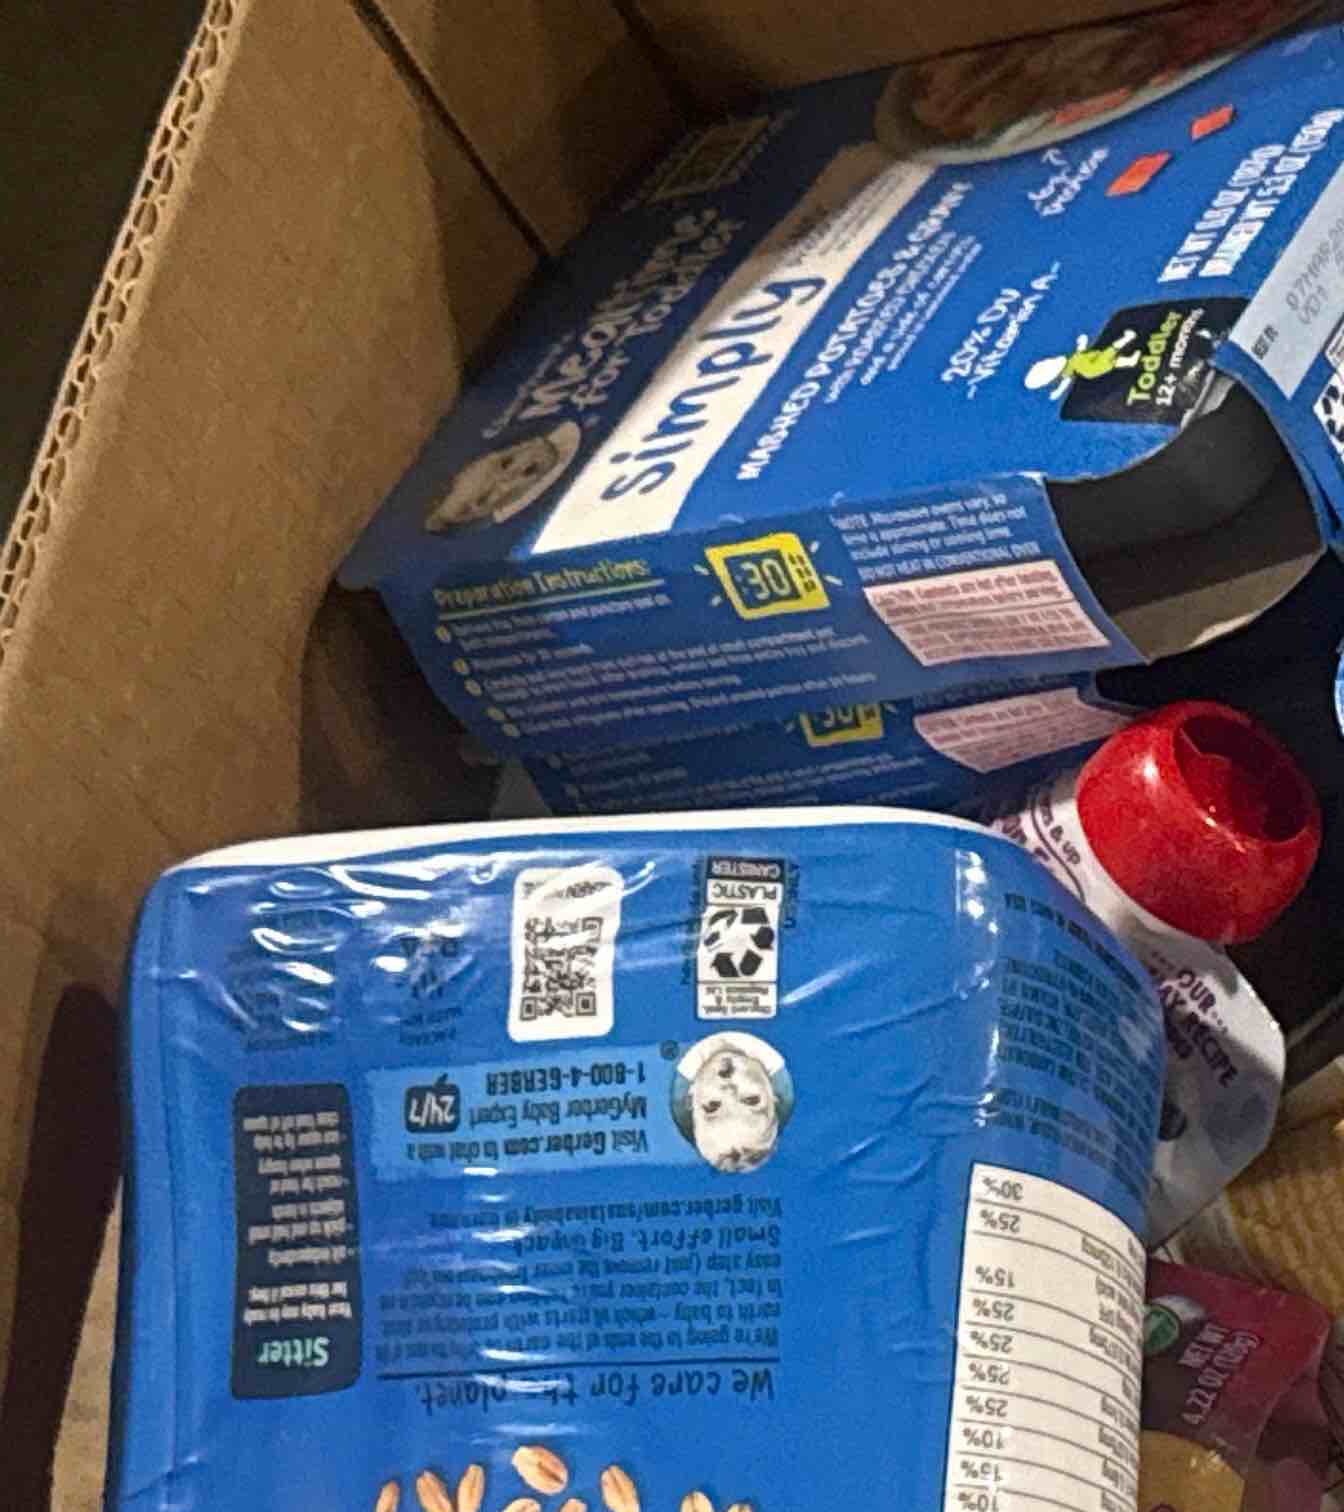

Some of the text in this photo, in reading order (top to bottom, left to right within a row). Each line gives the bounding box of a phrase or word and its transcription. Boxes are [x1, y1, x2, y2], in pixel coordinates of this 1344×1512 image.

[1127, 310, 1184, 406] Toddler
[601, 276, 828, 500] simply
[712, 882, 777, 899] PLASTIC
[485, 1061, 646, 1094] 1-800-4-GERBER
[408, 1092, 454, 1126] 24/7
[981, 1176, 1022, 1200] 30%
[979, 1209, 1020, 1232] 25%
[974, 1265, 1015, 1288] 15%
[257, 1336, 328, 1366] Sitter
